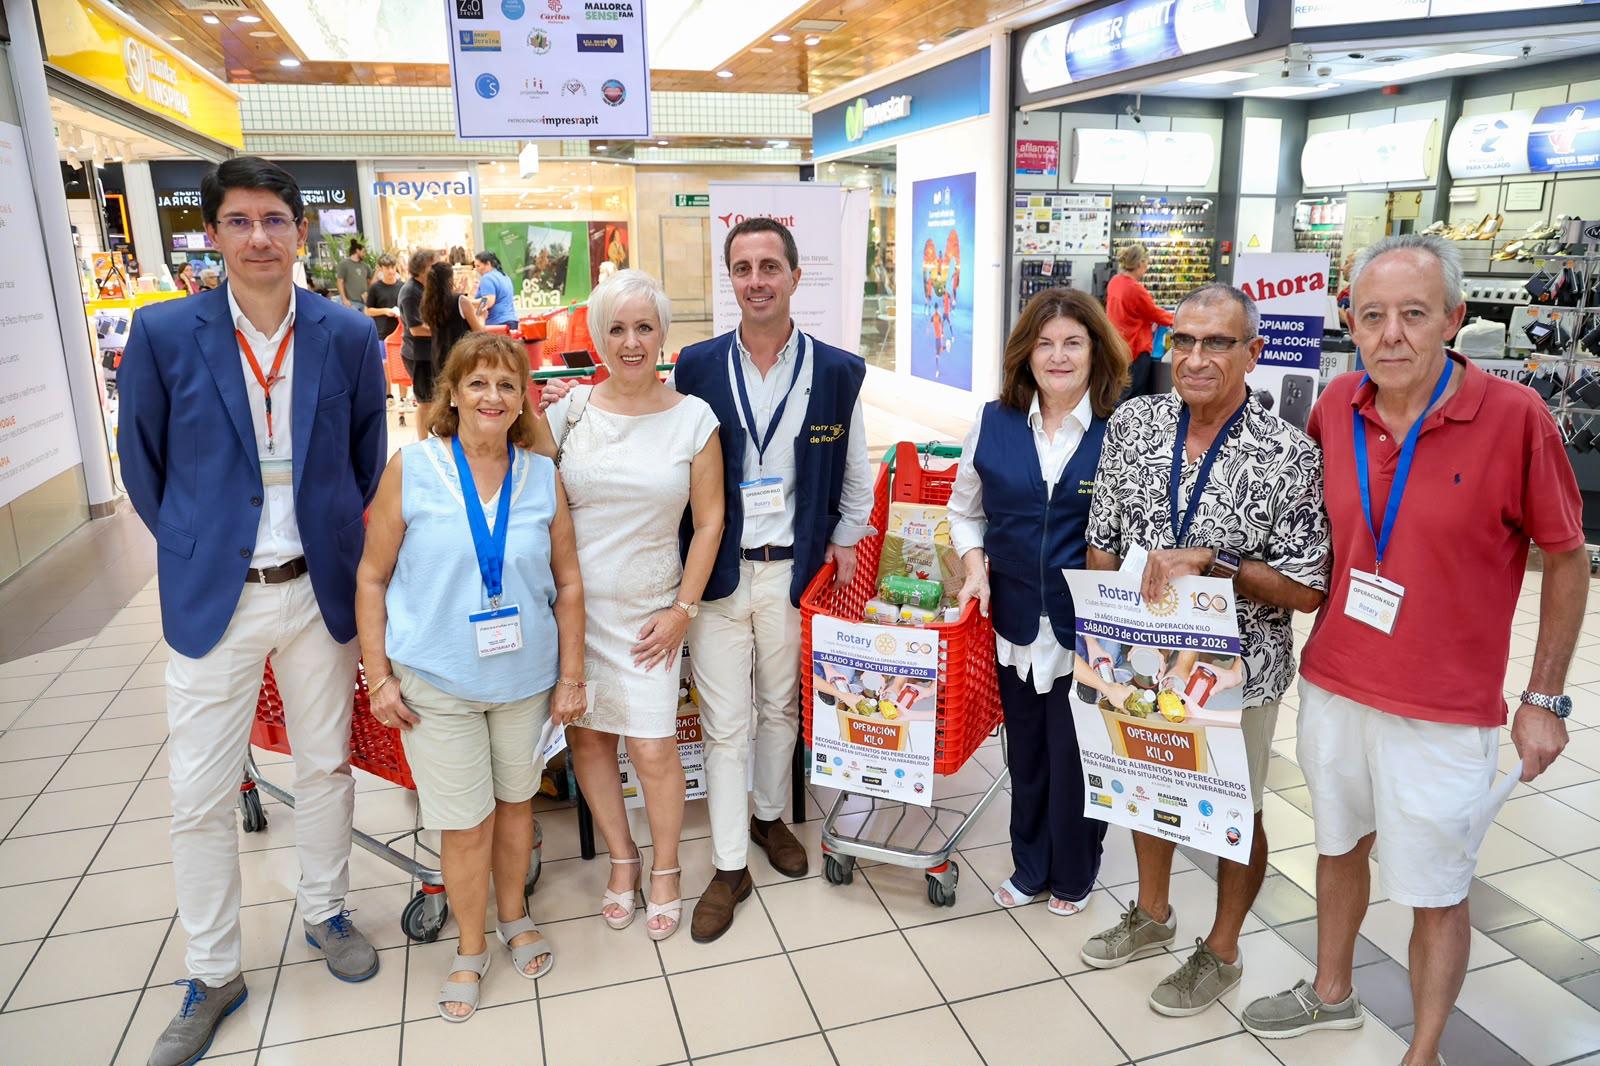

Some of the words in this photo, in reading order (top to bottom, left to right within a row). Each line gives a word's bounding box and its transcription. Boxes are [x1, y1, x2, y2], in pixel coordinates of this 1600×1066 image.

[584, 3, 632, 11] MALLORCA
[585, 11, 619, 21] SENSE
[542, 115, 599, 127] impresrapit
[1483, 162, 1511, 170] CALZADO
[373, 176, 473, 200] mayoral
[1241, 271, 1326, 302] Ahora
[1258, 320, 1305, 331] OPIAMOS
[1283, 336, 1321, 347] COCHE
[1264, 350, 1303, 361] MANDO
[1098, 583, 1142, 606] Rotary
[1383, 600, 1395, 608] KILO
[1101, 612, 1113, 621] AÑOS
[1113, 616, 1145, 627] CELEBRANDO
[1155, 622, 1194, 631] OPERACIÓN
[1195, 624, 1211, 632] KILO
[836, 631, 872, 648] Rotary
[1083, 621, 1114, 636] SÁBADO
[1115, 628, 1120, 637] 3
[1121, 629, 1131, 639] de
[1132, 631, 1183, 645] OCTUBRE
[1185, 635, 1199, 646] de
[1201, 637, 1228, 649] 2026
[820, 653, 848, 664] SÁBADO
[864, 662, 898, 673] OCTUBRE
[899, 666, 909, 674] de
[910, 668, 928, 676] 2026
[852, 721, 897, 737] OPERACIÓN
[864, 734, 884, 746] KILO
[1127, 726, 1191, 749] OPERACIÓN
[815, 735, 841, 746] RECOGIDA
[850, 743, 880, 755] ALIMENTOS
[891, 751, 930, 762] PERECEDEROS
[1145, 745, 1174, 762] KILO
[1081, 749, 1117, 765] RECOGIDA
[1117, 758, 1127, 767] DE
[1129, 761, 1173, 777] ALIMENTOS
[1173, 770, 1187, 779] NO
[1188, 772, 1247, 792] PERECEDEROS
[1083, 757, 1099, 767] PARA
[1099, 761, 1127, 774] FAMILIAS
[1127, 768, 1137, 776] EN
[1137, 770, 1173, 784] SITUACIÓN
[1185, 780, 1247, 800] VULNERABILIDAD
[1157, 792, 1188, 803] MALLORCA
[1157, 827, 1191, 842] impresrapit
